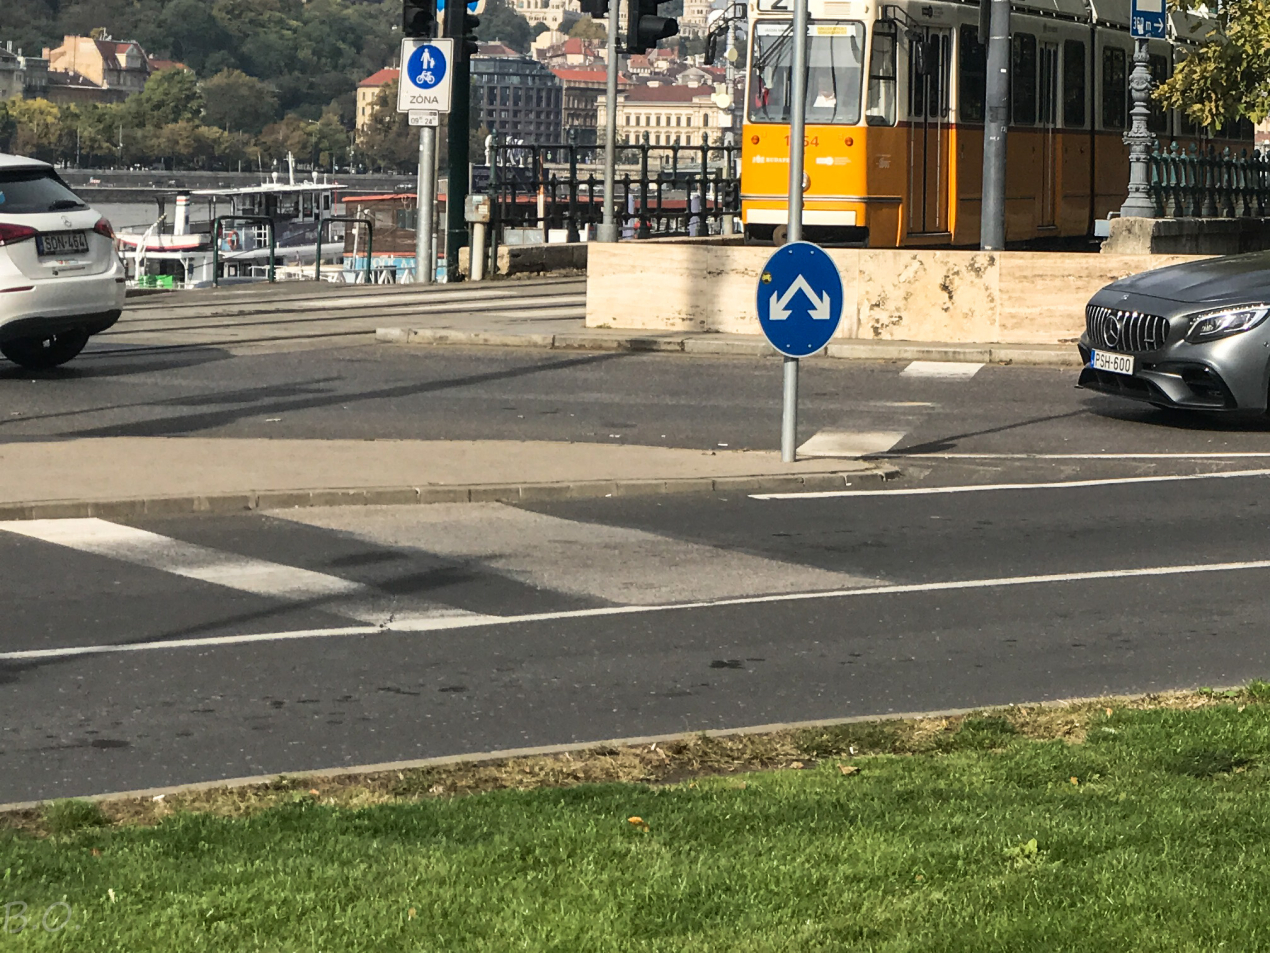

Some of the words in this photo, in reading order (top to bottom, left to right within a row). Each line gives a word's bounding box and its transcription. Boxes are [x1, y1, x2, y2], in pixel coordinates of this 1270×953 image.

[409, 94, 439, 104] ZÓNA
[44, 233, 85, 250] SDN-464
[1095, 352, 1131, 373] PSH-600
